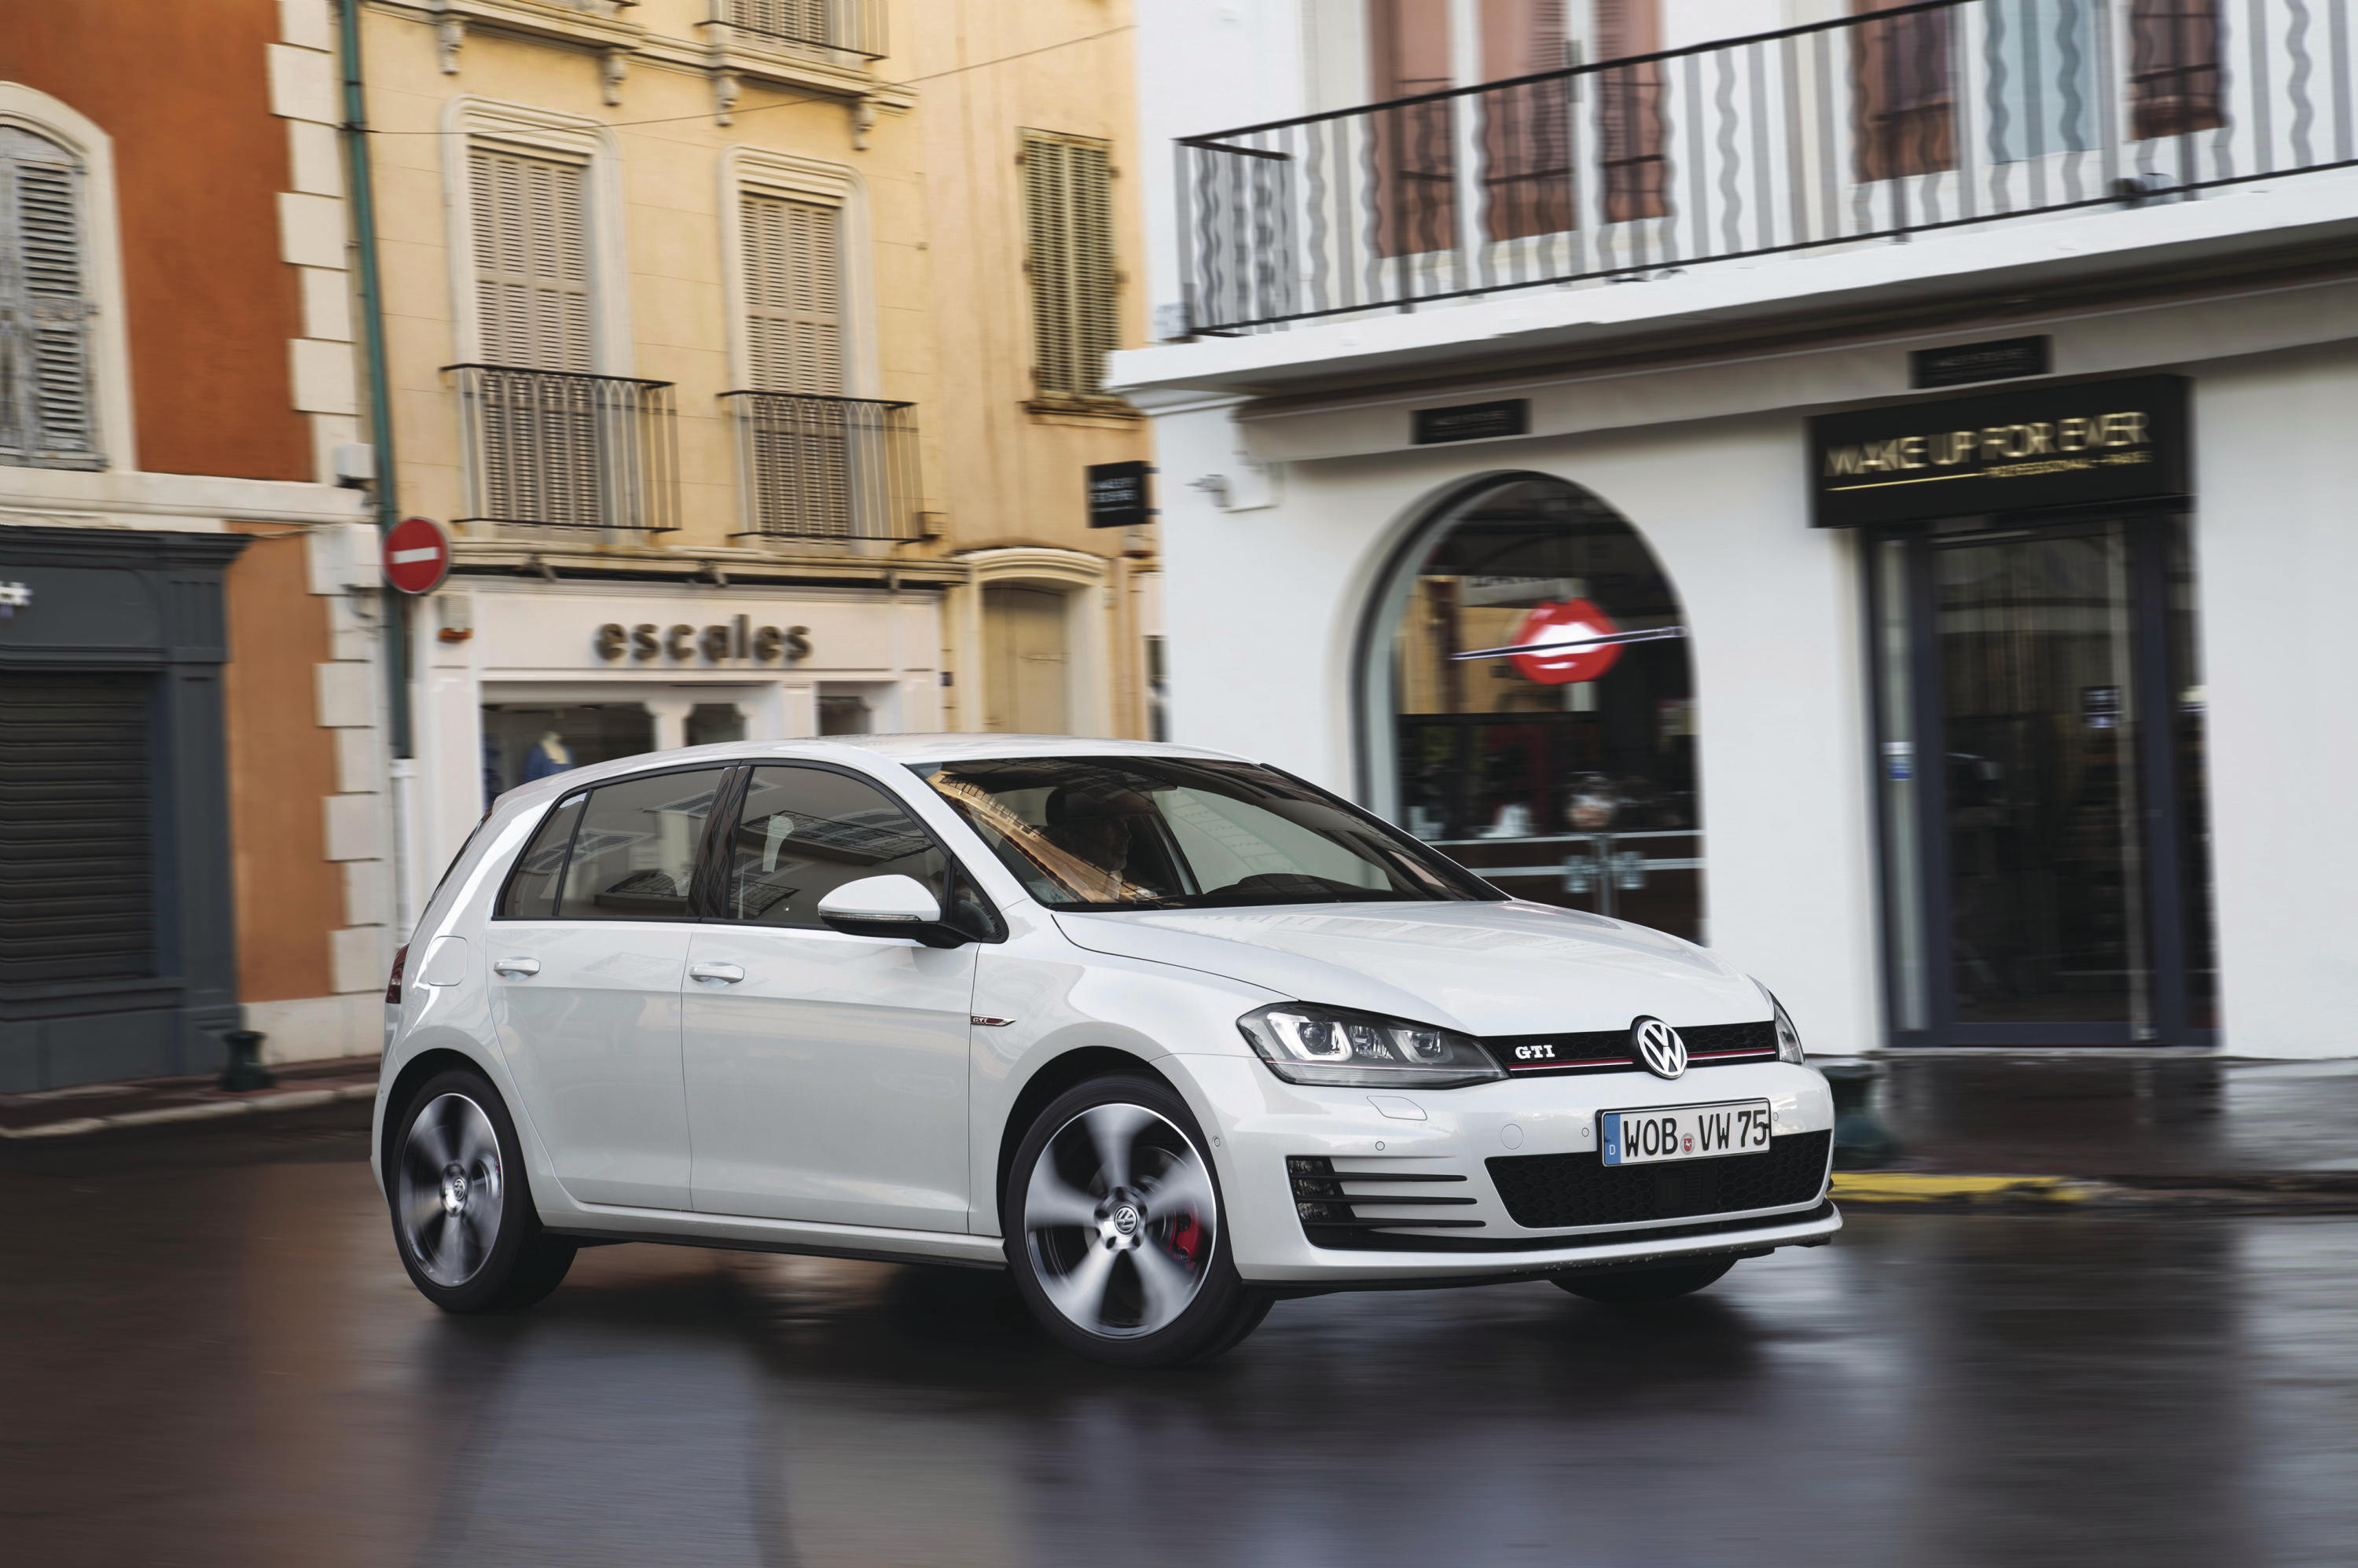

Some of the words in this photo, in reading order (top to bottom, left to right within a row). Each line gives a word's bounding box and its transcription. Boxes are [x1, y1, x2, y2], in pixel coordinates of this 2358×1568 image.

[1927, 431, 1979, 464] UP
[1980, 422, 2058, 461] FOR
[2057, 412, 2151, 451] EVER
[593, 612, 814, 661] escales
[1515, 1045, 1555, 1059] GTI
[1637, 1019, 1688, 1078] VW
[1609, 1144, 1616, 1155] D
[1623, 1118, 1678, 1158] WOB
[1698, 1112, 1731, 1151] VW
[1737, 1109, 1767, 1146] 75
